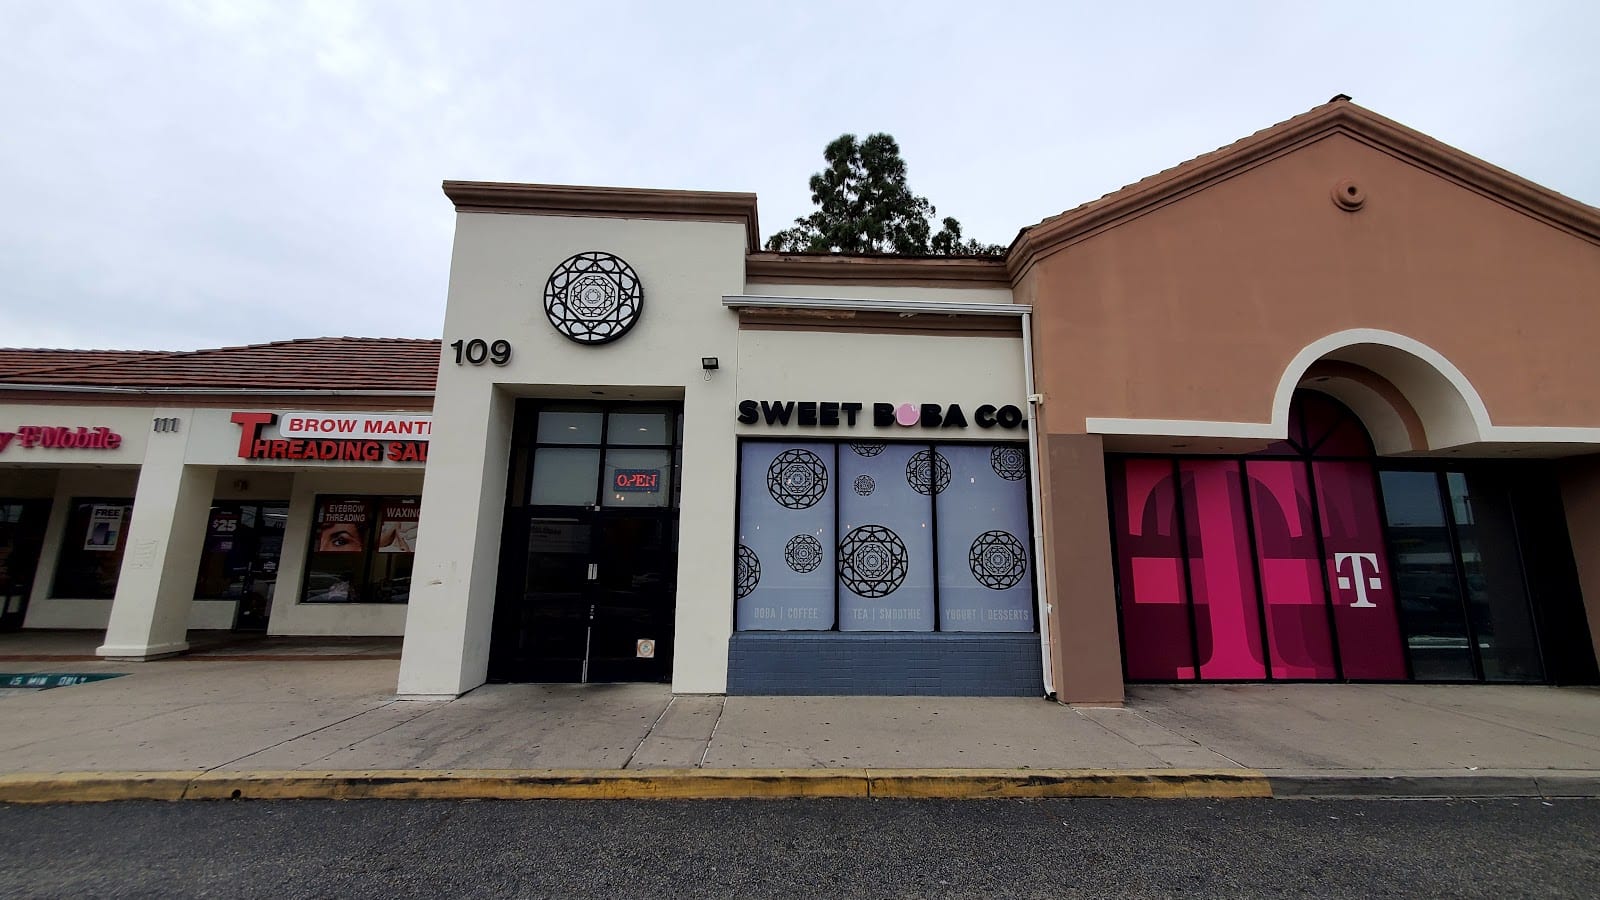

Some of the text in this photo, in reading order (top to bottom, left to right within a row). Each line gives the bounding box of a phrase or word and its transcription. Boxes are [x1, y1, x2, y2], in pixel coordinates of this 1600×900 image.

[450, 338, 512, 367] 109
[738, 399, 863, 426] SWEET
[153, 417, 179, 433] 111
[289, 418, 358, 434] BROW
[230, 411, 384, 462] THREADING
[616, 474, 657, 487] OPEN
[94, 508, 121, 517] FREE
[329, 504, 365, 513] EYEBROW
[326, 513, 366, 522] THREADING
[212, 519, 237, 532] $25
[787, 607, 819, 619] COFFEE
[852, 608, 921, 621] TEA SMOOTHIE
[945, 608, 1029, 622] YOGURT DESSERTS
[27, 676, 48, 685] MIN
[58, 676, 88, 686] ONLY
